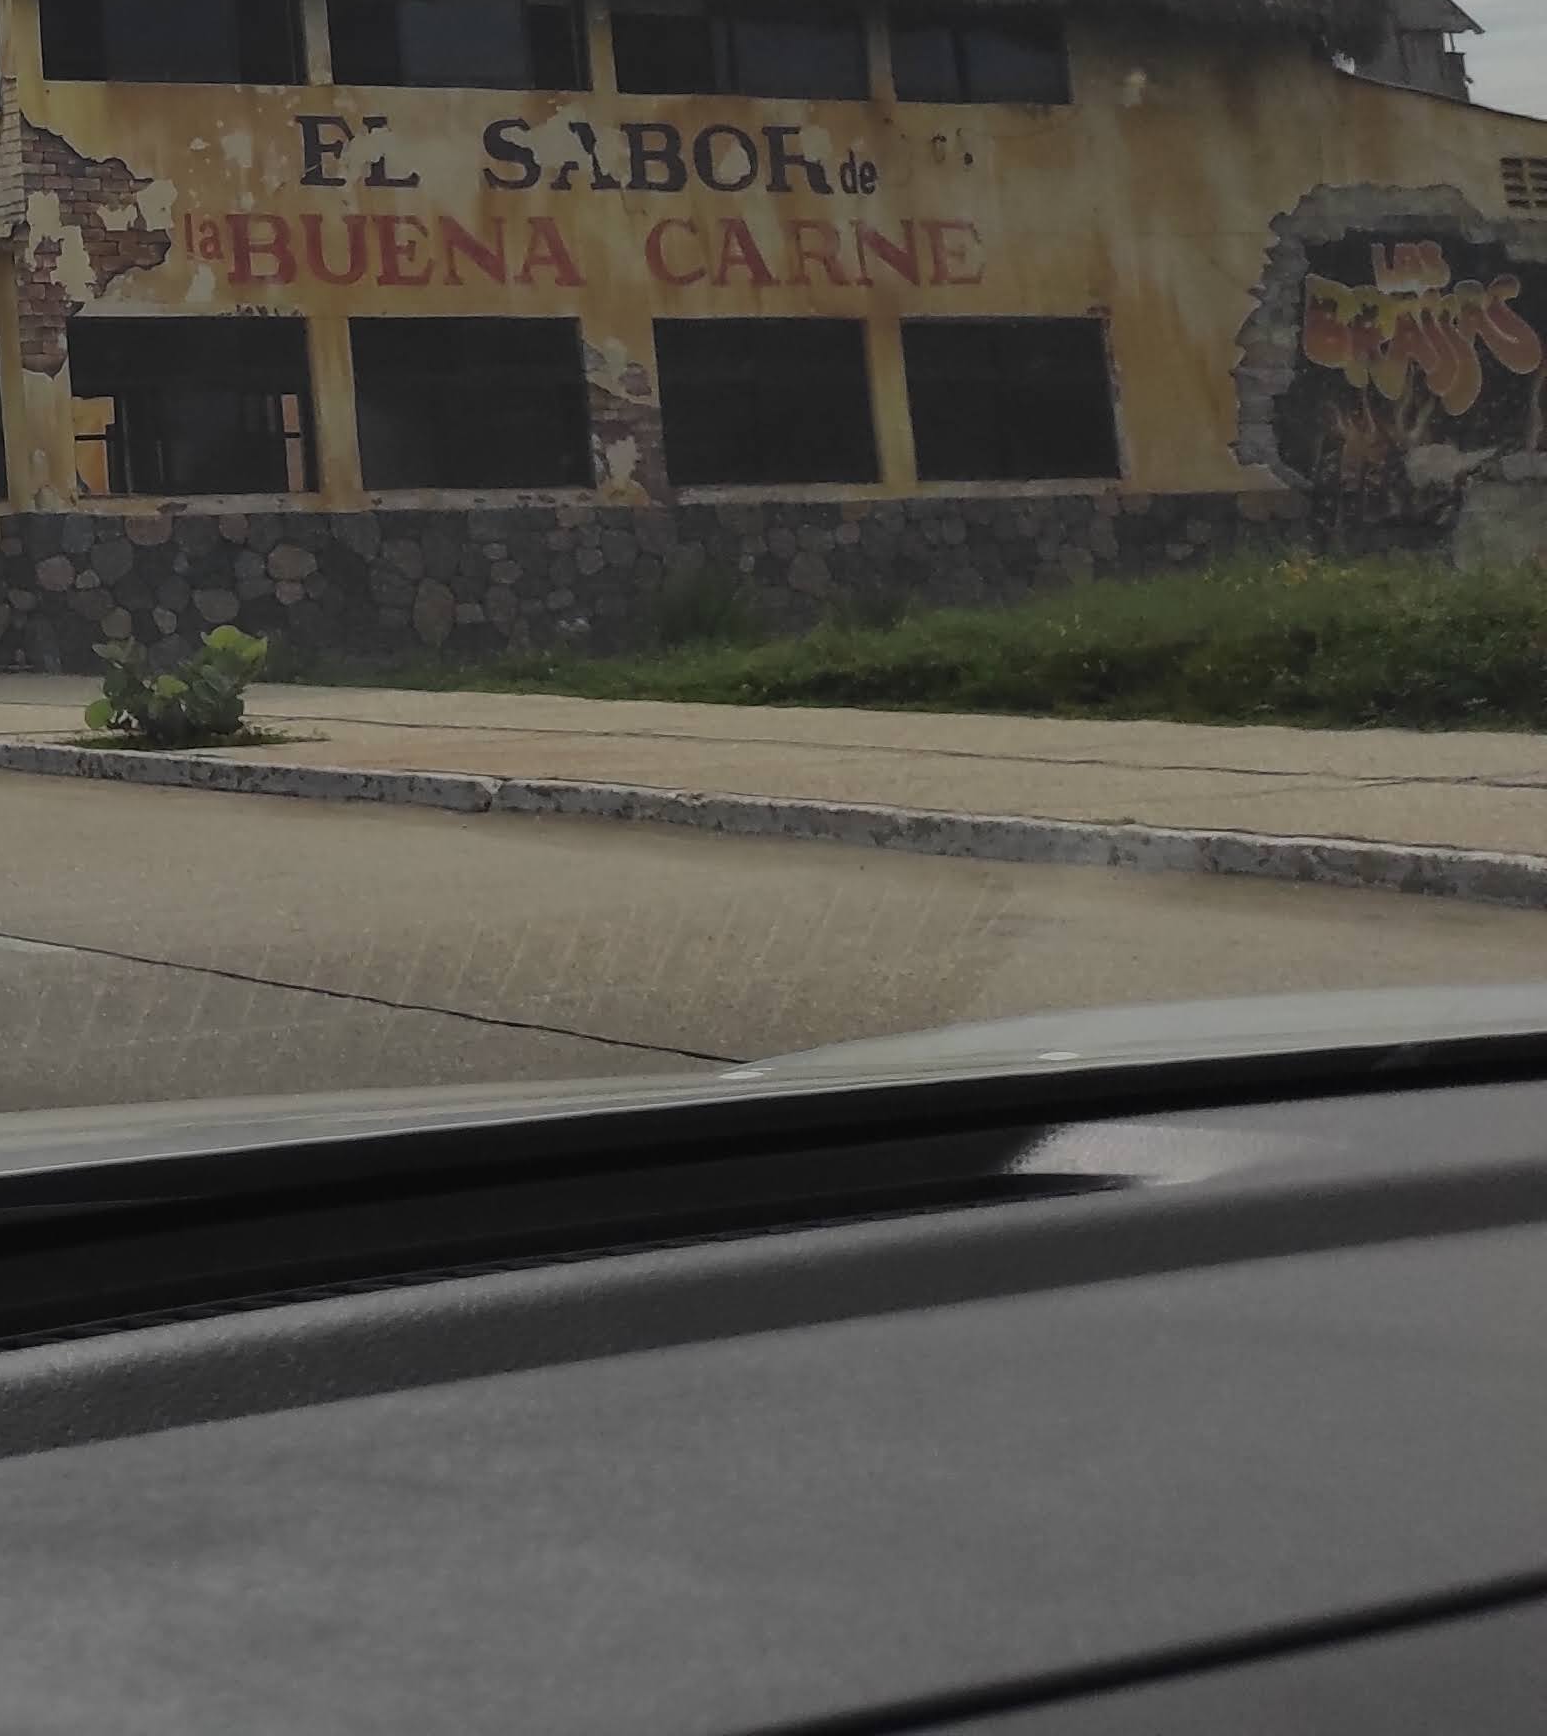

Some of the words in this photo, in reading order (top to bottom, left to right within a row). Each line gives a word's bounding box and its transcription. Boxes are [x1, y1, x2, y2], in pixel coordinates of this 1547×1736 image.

[294, 115, 421, 188] EL
[839, 148, 878, 196] de
[183, 212, 225, 261] la
[224, 212, 588, 288] BUENA
[643, 216, 989, 289] CARNE
